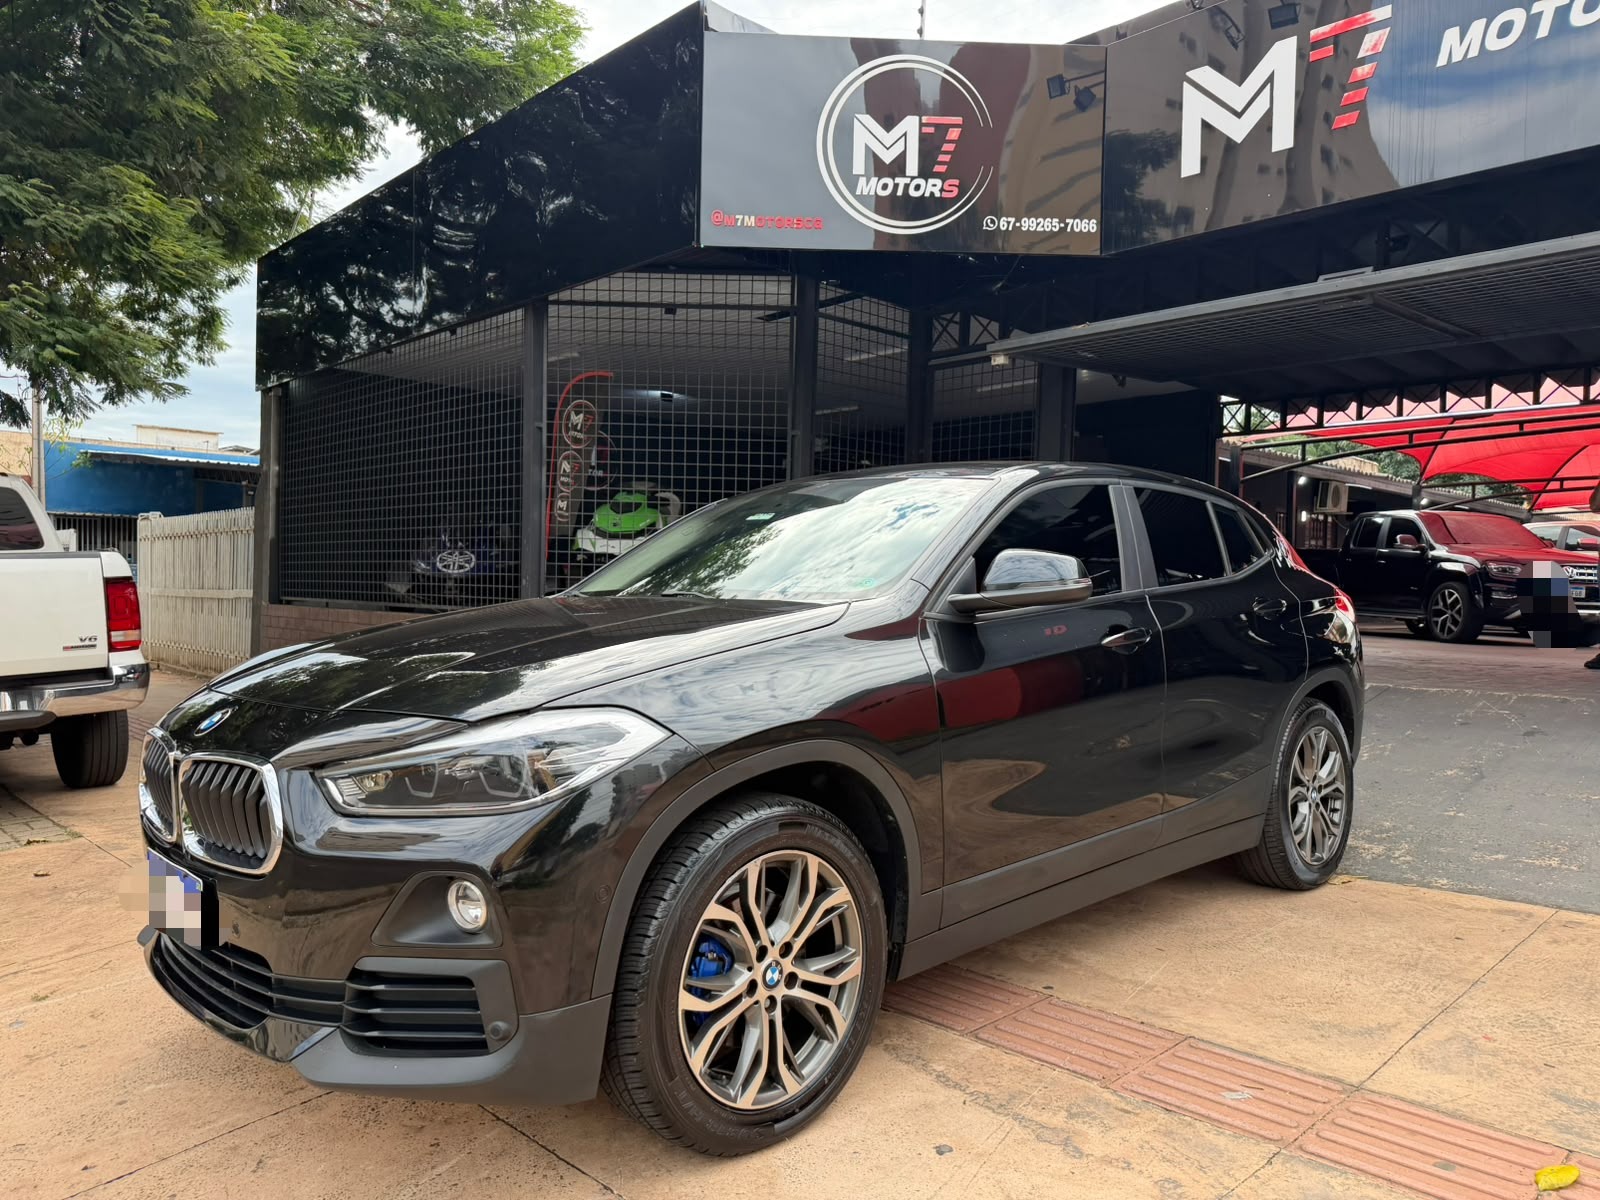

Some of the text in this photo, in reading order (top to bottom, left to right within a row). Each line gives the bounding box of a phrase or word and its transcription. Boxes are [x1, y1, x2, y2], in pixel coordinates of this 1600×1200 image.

[1181, 5, 1392, 178] M7
[852, 113, 963, 177] M7
[855, 176, 960, 198] MOTORS
[1000, 216, 1097, 232] 67-99265-7066
[79, 635, 98, 643] V6
